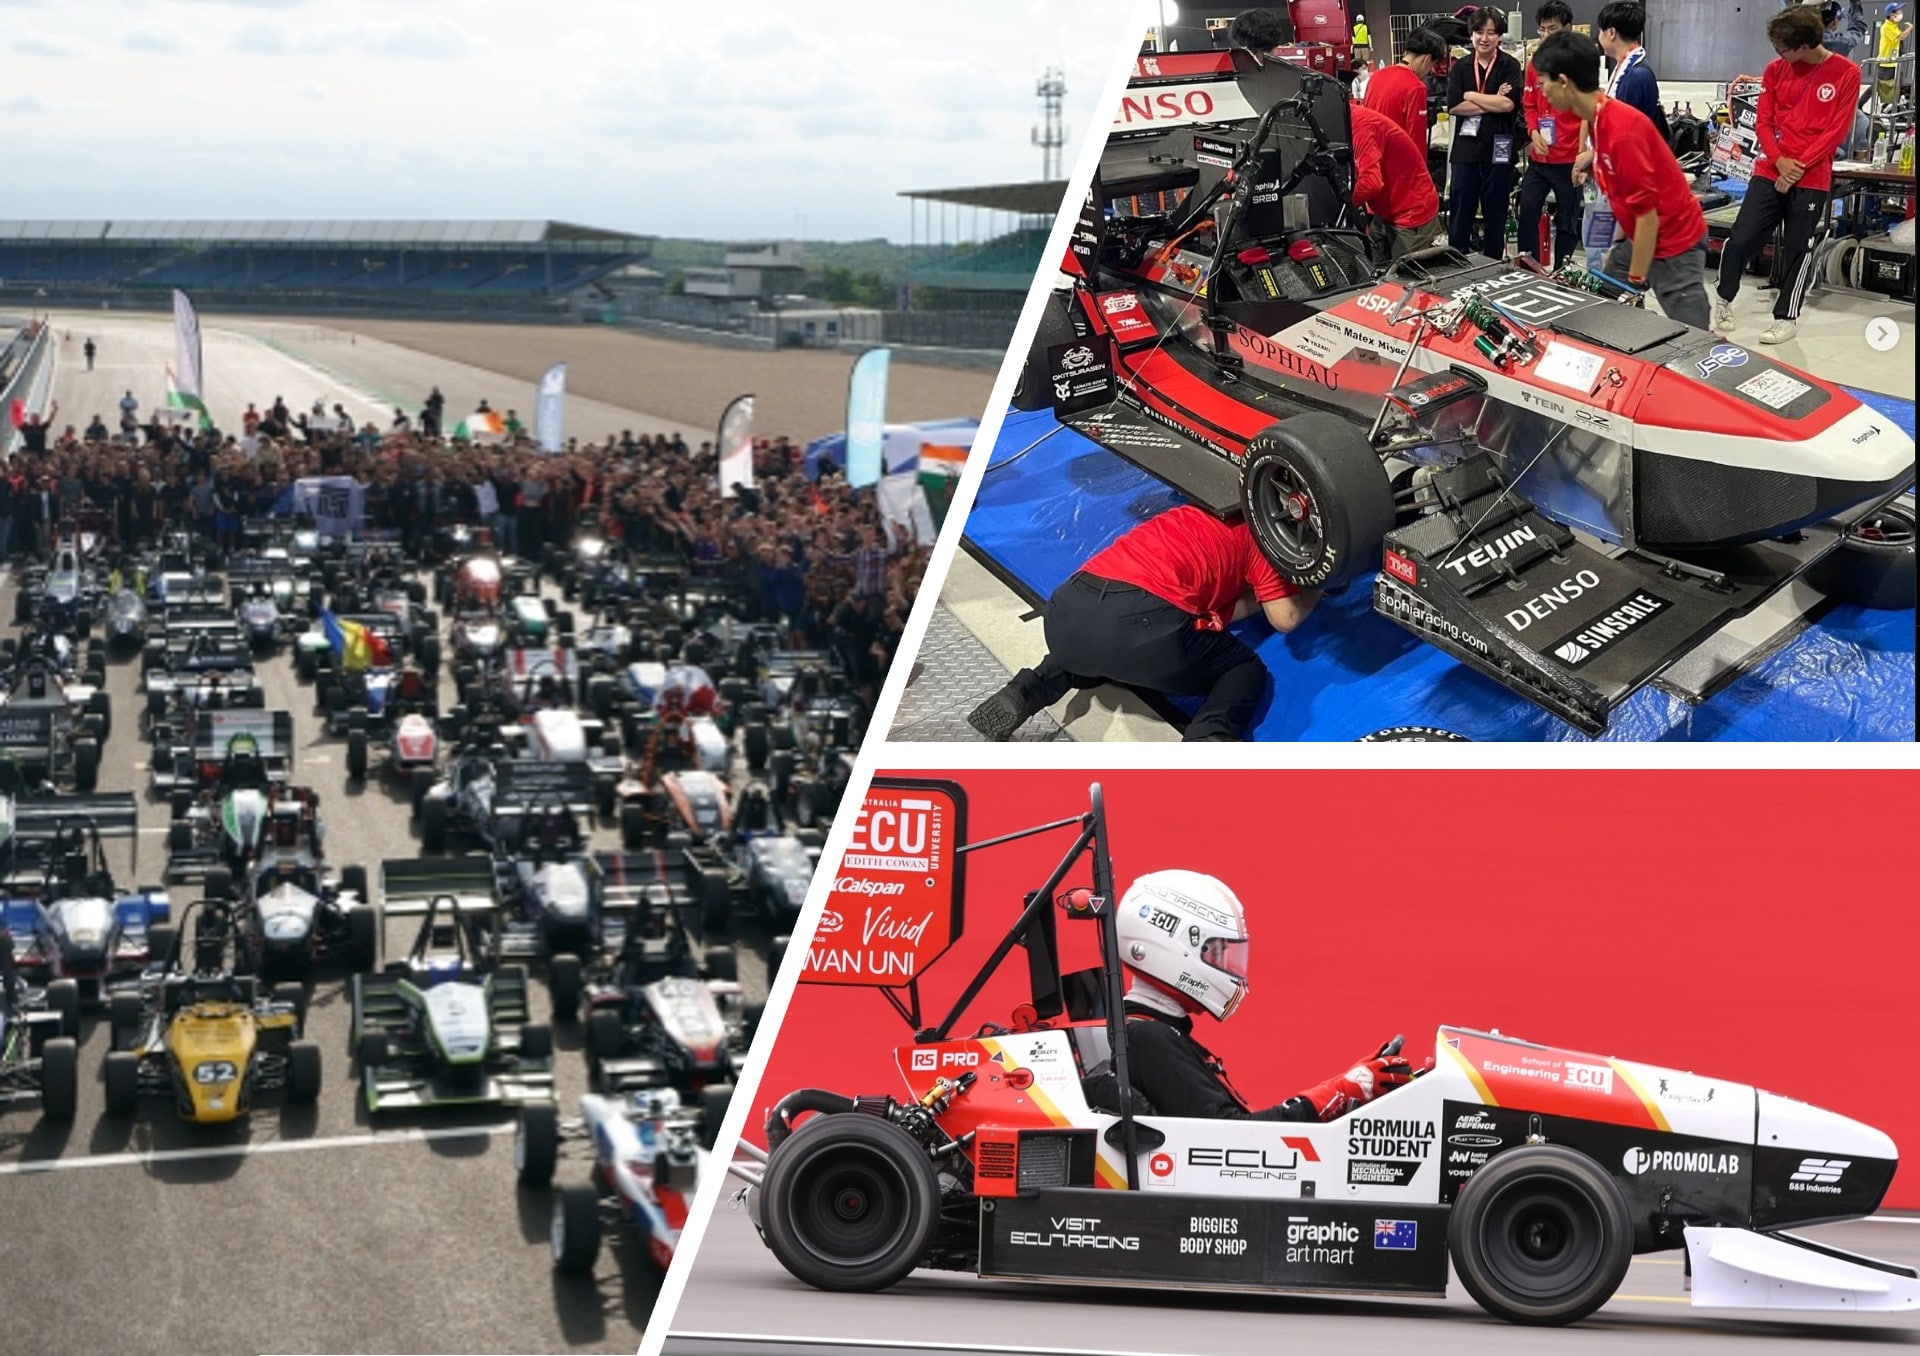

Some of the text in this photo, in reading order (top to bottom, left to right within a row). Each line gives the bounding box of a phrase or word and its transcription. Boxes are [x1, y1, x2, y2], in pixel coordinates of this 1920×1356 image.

[1113, 90, 1213, 123] NSO
[1343, 327, 1374, 346] Matex
[1533, 395, 1565, 414] TEIN
[1444, 525, 1536, 576] TEIJIN
[1504, 569, 1600, 632] DENSO
[1379, 592, 1488, 654] sophiaracing.com
[1575, 594, 1663, 650] SIMSCALE
[846, 810, 927, 855] ECU
[930, 804, 942, 870] UNIVERSITY
[846, 856, 928, 869] EDITH COWAN
[838, 877, 905, 898] Calspan
[862, 906, 934, 948] Vivid
[868, 950, 914, 975] UNI
[1179, 974, 1210, 991] graphic
[915, 1052, 979, 1067] RS PRO
[1521, 1056, 1562, 1069] School of
[197, 1063, 236, 1083] 52
[1483, 1060, 1560, 1083] Engineering
[1349, 1118, 1436, 1139] FORMULA
[1455, 1121, 1497, 1130] DEFENCE
[1457, 1115, 1482, 1123] AERO
[1348, 1137, 1432, 1158] STUDENT
[1352, 1167, 1404, 1176] MECHANICAL
[1652, 1150, 1739, 1175] PROMOLAB
[1219, 1170, 1297, 1181] RACING
[1351, 1174, 1395, 1182] ENGINEERS
[1806, 1183, 1842, 1194] Industries
[1050, 1216, 1101, 1232] VISIT
[1190, 1216, 1239, 1234] BIGGIES
[1287, 1221, 1360, 1245] graphic
[1179, 1237, 1247, 1256] BODY SHOP
[1286, 1245, 1354, 1265] art mart
